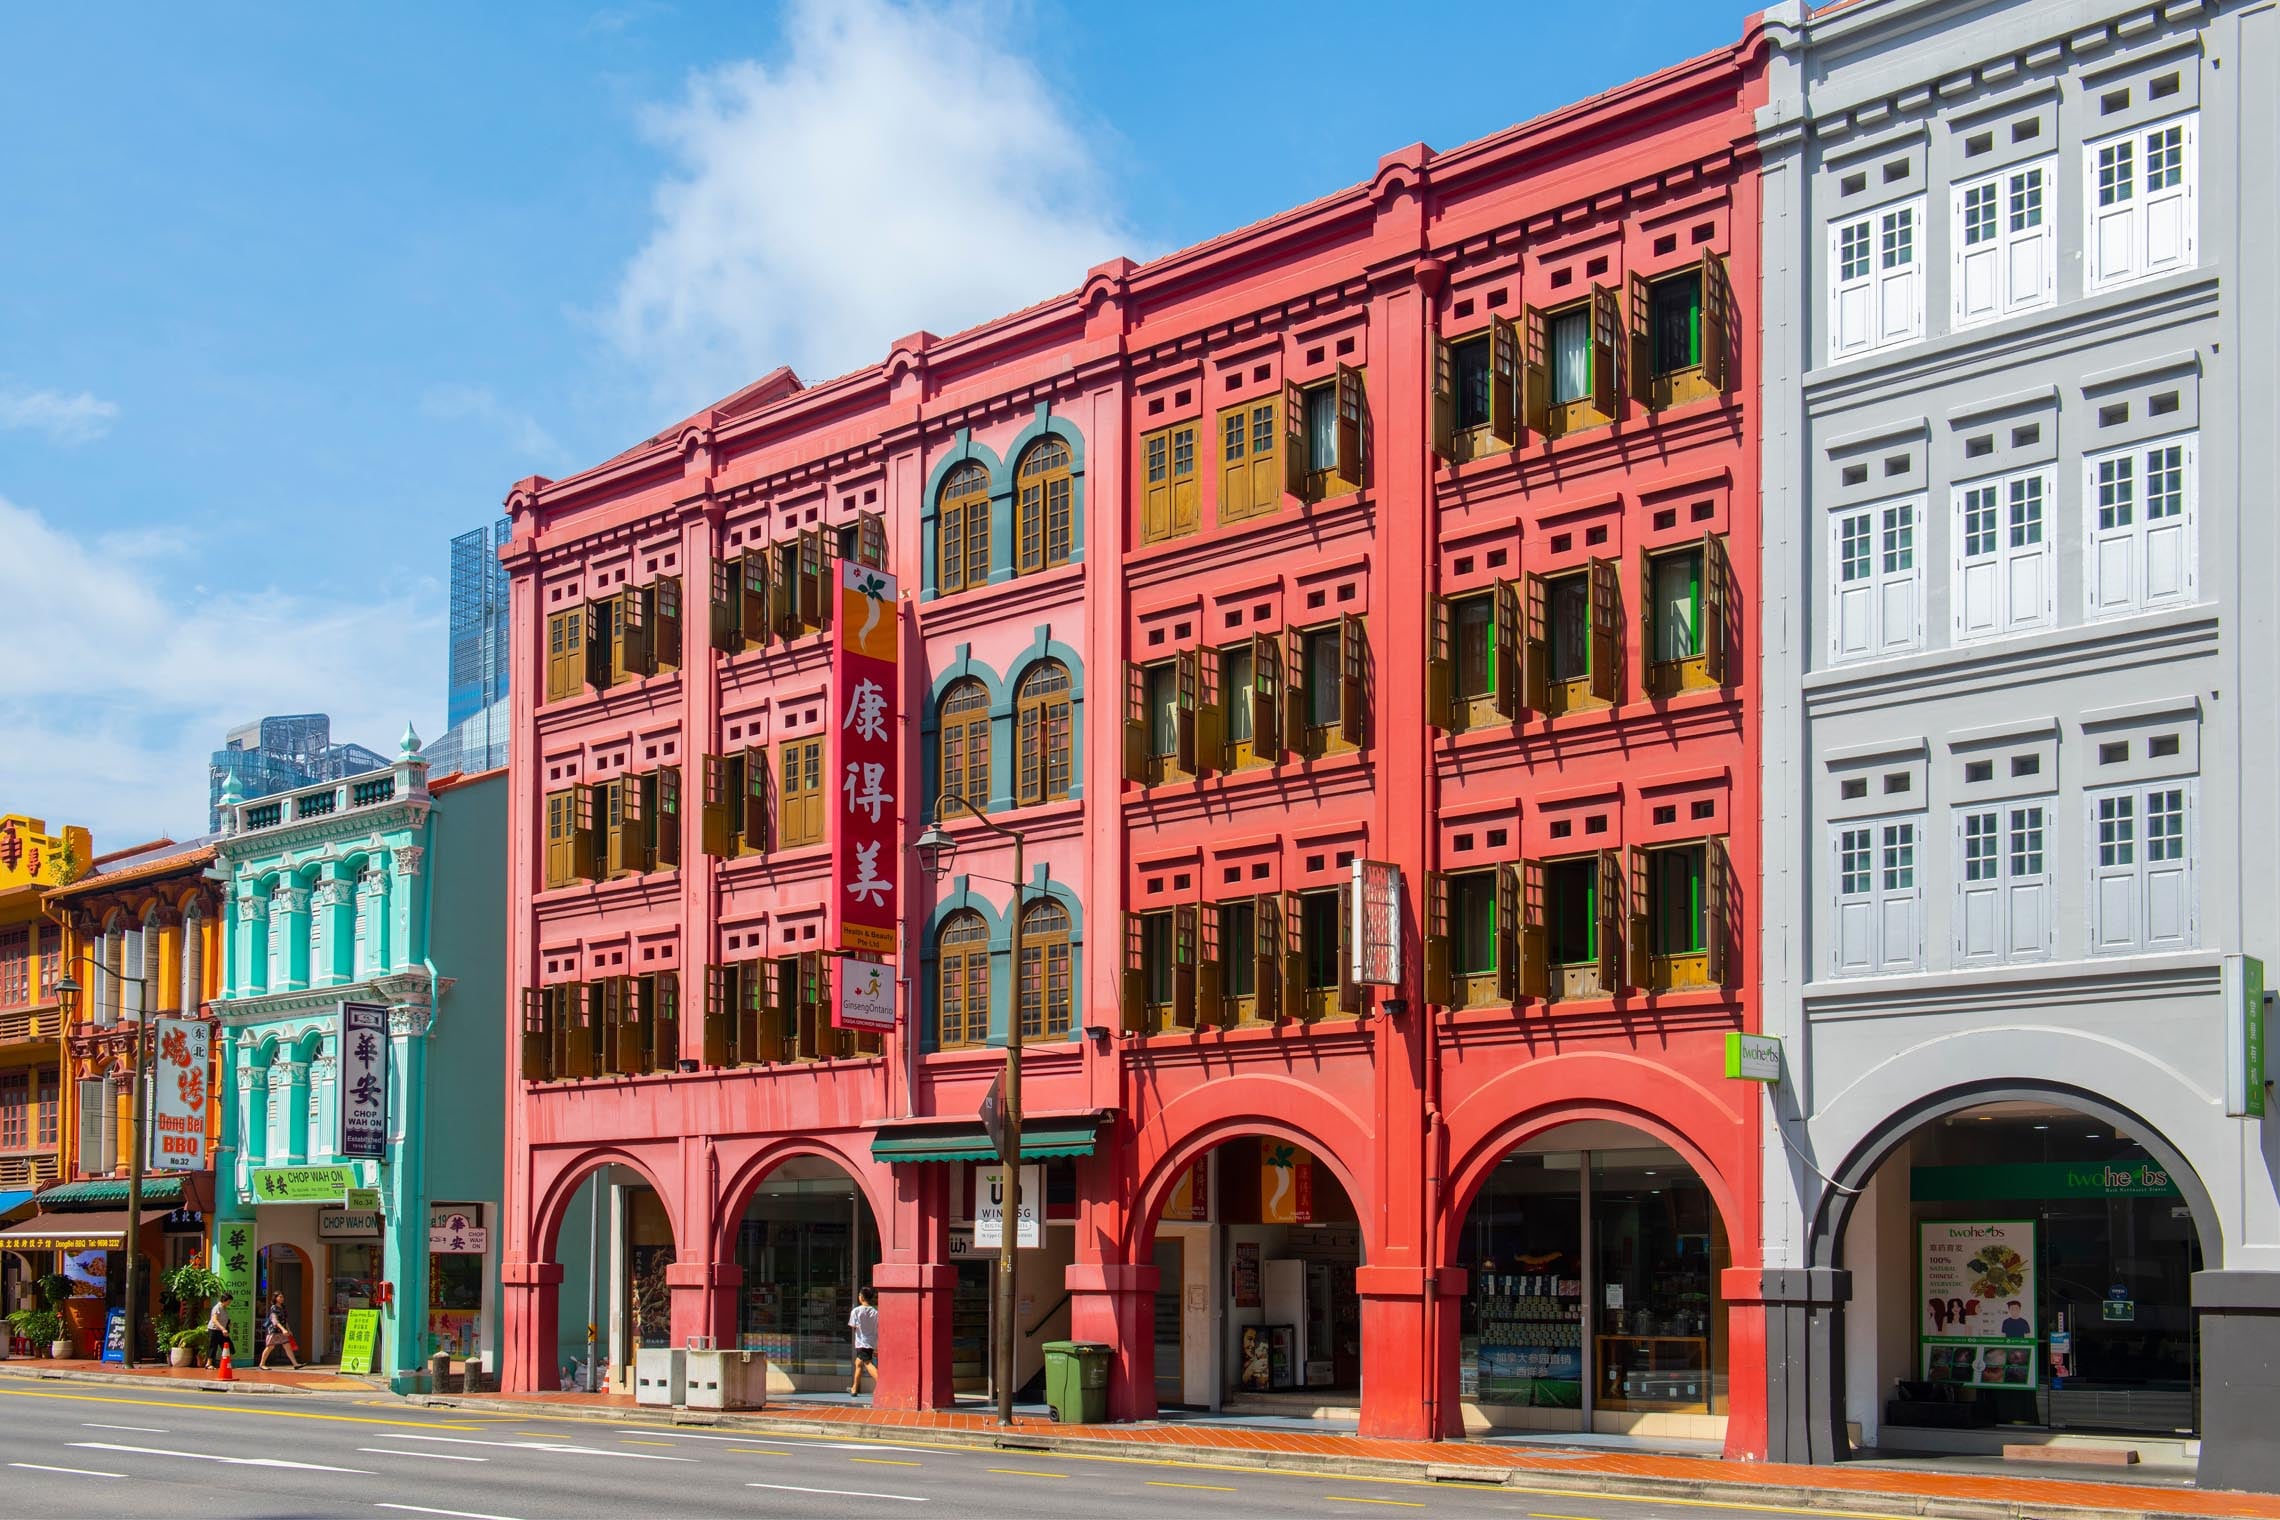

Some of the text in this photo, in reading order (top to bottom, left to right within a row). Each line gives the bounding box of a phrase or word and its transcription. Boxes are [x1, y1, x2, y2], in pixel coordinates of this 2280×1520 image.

[843, 678, 894, 907] 康得美
[857, 938, 868, 946] Pte
[871, 931, 893, 941] Beauty
[349, 1033, 381, 1107] 華安
[348, 1118, 382, 1127] WAH ON
[354, 1110, 377, 1118] CHOP
[158, 1113, 203, 1134] Dong Bei
[163, 1135, 198, 1156] BBQ
[170, 1158, 189, 1166] No.32
[264, 1174, 288, 1196] 華安
[287, 1170, 344, 1183] CHOP WAH ON
[323, 1216, 378, 1229] CHOP WAH ON
[449, 1216, 466, 1250] 華安
[227, 1229, 248, 1272] 華安
